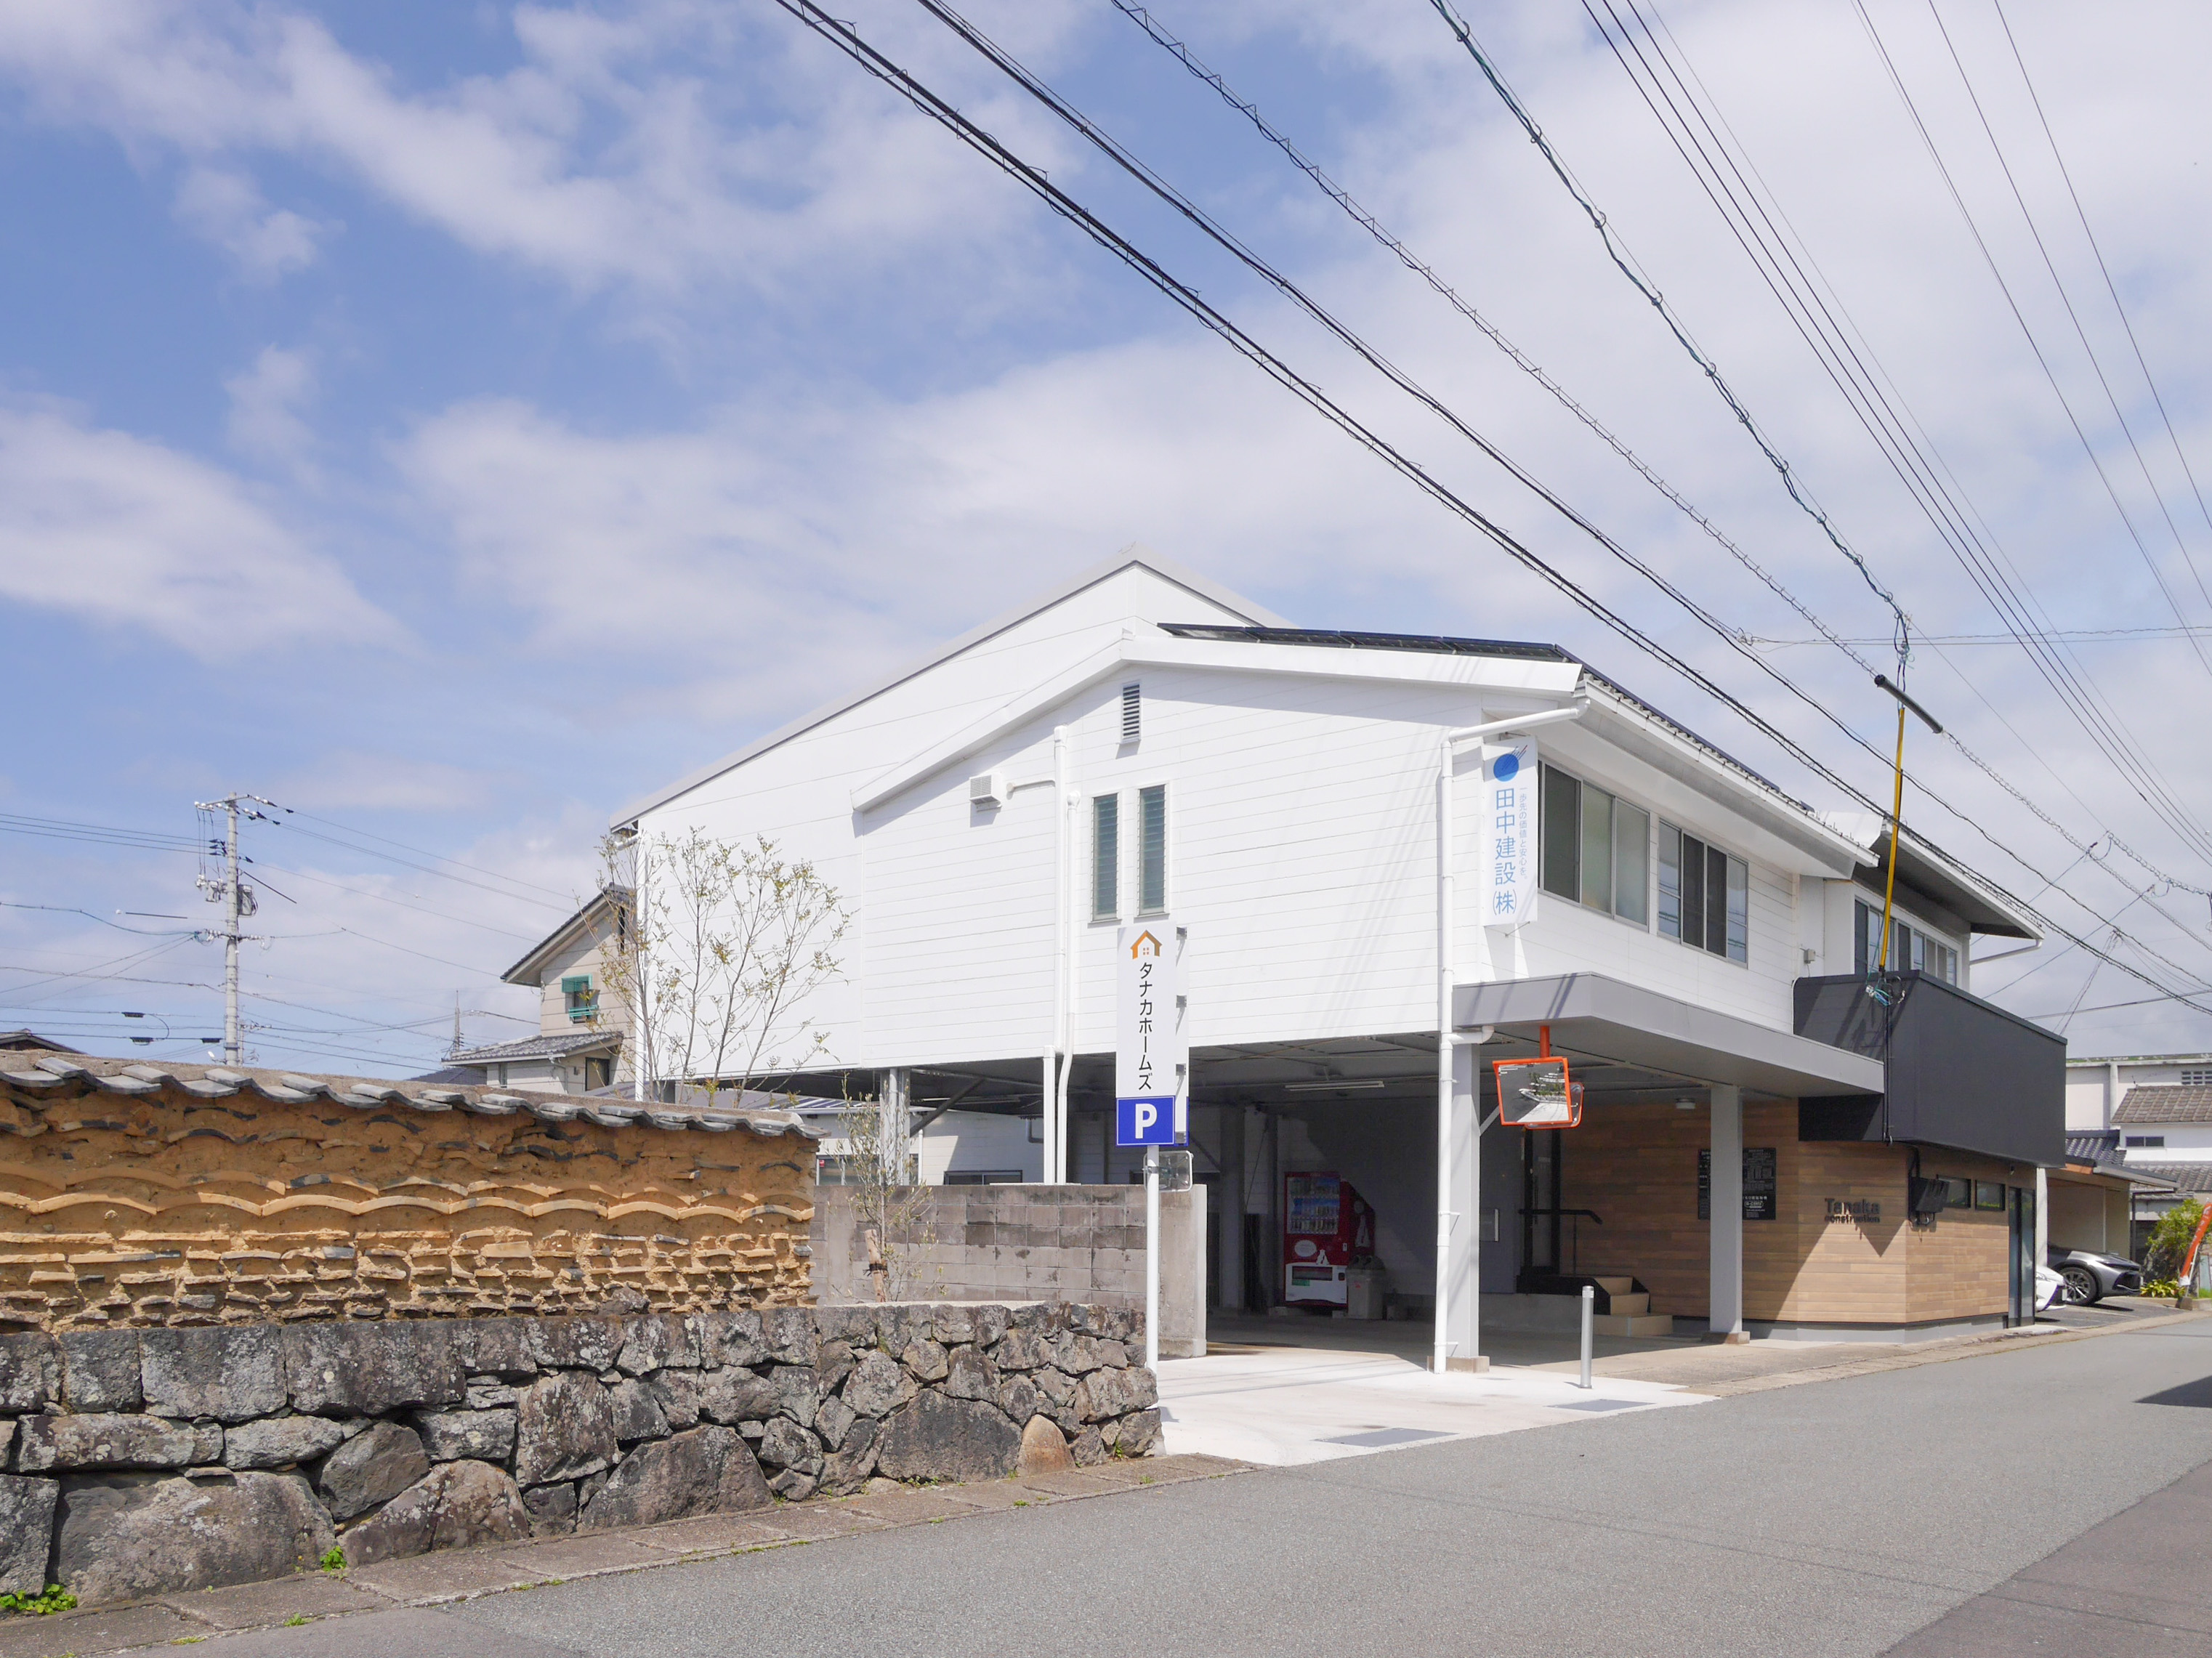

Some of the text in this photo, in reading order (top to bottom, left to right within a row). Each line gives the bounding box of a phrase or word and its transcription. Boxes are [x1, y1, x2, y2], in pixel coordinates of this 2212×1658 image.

[1493, 788, 1517, 915] 田中建設(株)
[1138, 962, 1153, 1090] タナカホームズ
[1135, 1104, 1157, 1139] P
[1825, 1198, 1880, 1214] Tanaka
[1825, 1214, 1880, 1224] construction
